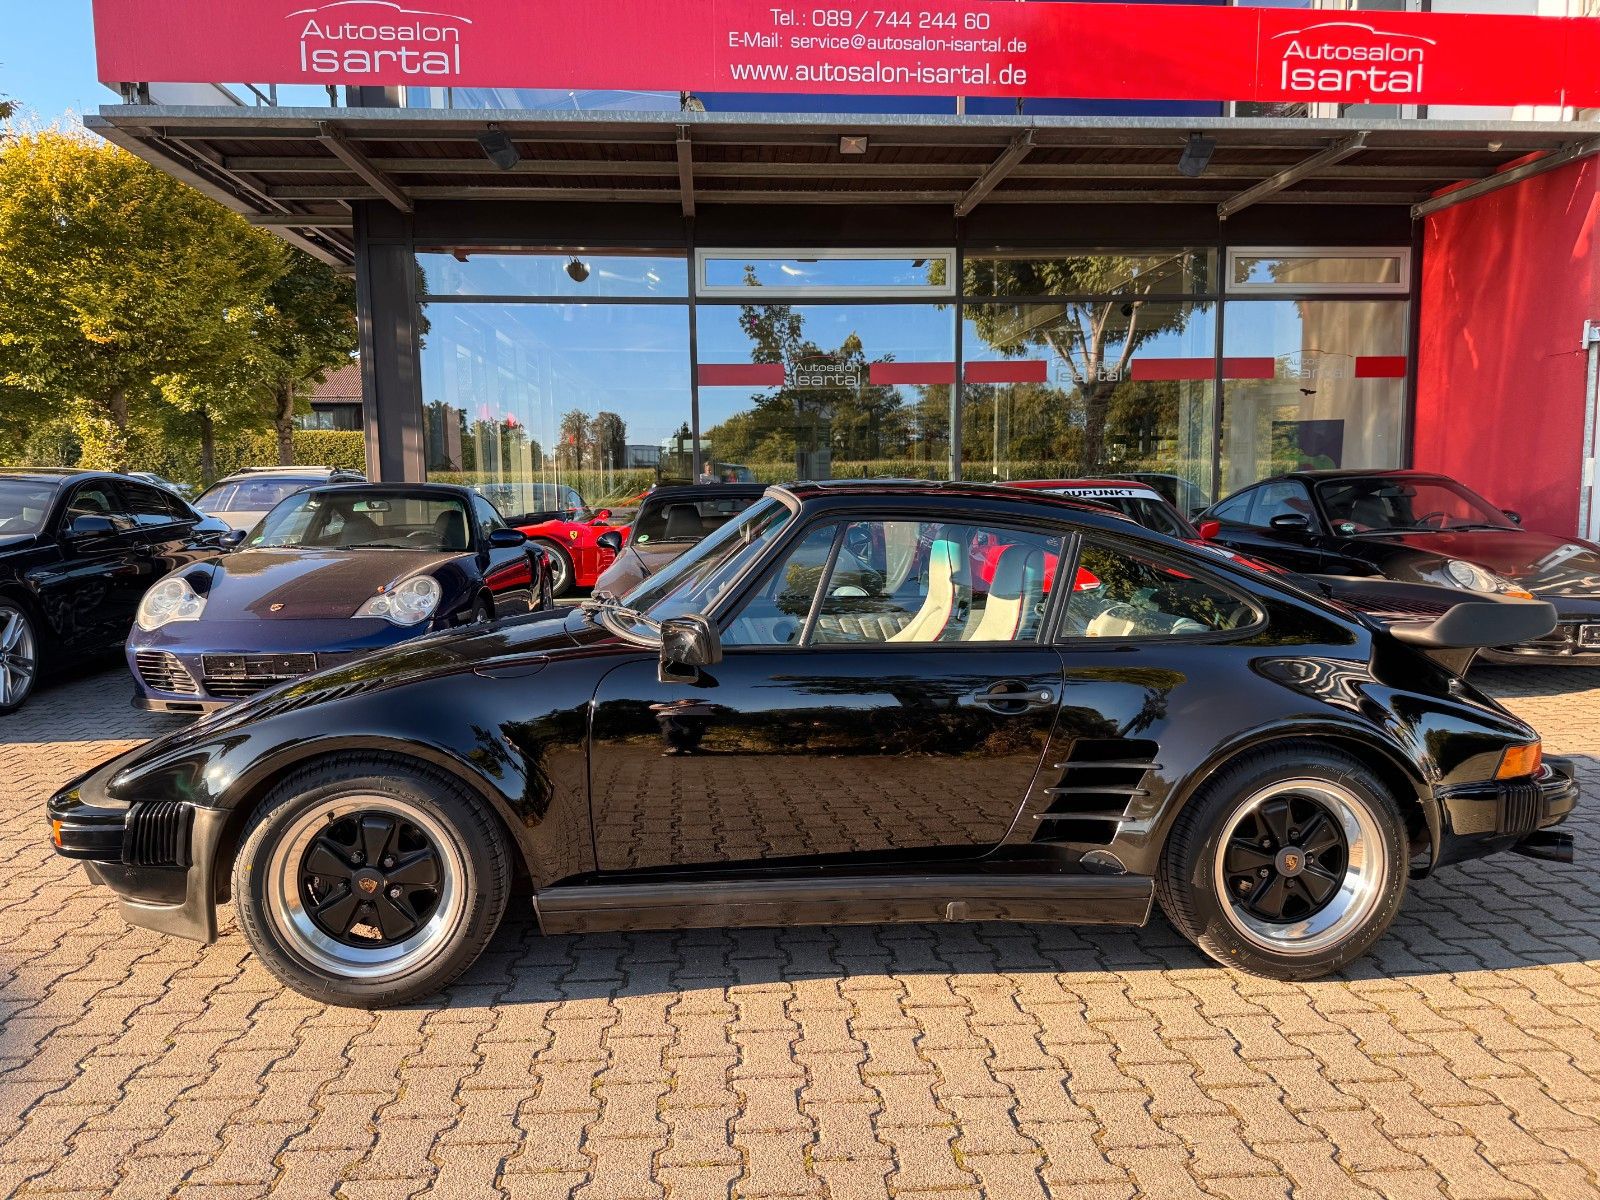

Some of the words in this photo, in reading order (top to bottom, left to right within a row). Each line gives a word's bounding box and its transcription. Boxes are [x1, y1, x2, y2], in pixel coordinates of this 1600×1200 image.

[770, 9, 806, 26] Tel.:
[812, 10, 852, 27] 089
[855, 11, 868, 29] /
[873, 11, 912, 29] 744
[919, 12, 957, 30] 244
[965, 13, 990, 30] 60
[301, 19, 459, 42] Autosalon
[729, 32, 783, 48] E-Mail:
[790, 34, 1027, 53] service@autosalon-isartal.de
[1283, 40, 1424, 62] Autosalon
[300, 41, 460, 75] Isartal
[730, 61, 1027, 85] www.autosalon-isartal.de
[1281, 61, 1423, 93] Isartal
[795, 362, 861, 372] Autosalon
[1056, 366, 1123, 382] Isatal
[794, 371, 861, 386] Isartal
